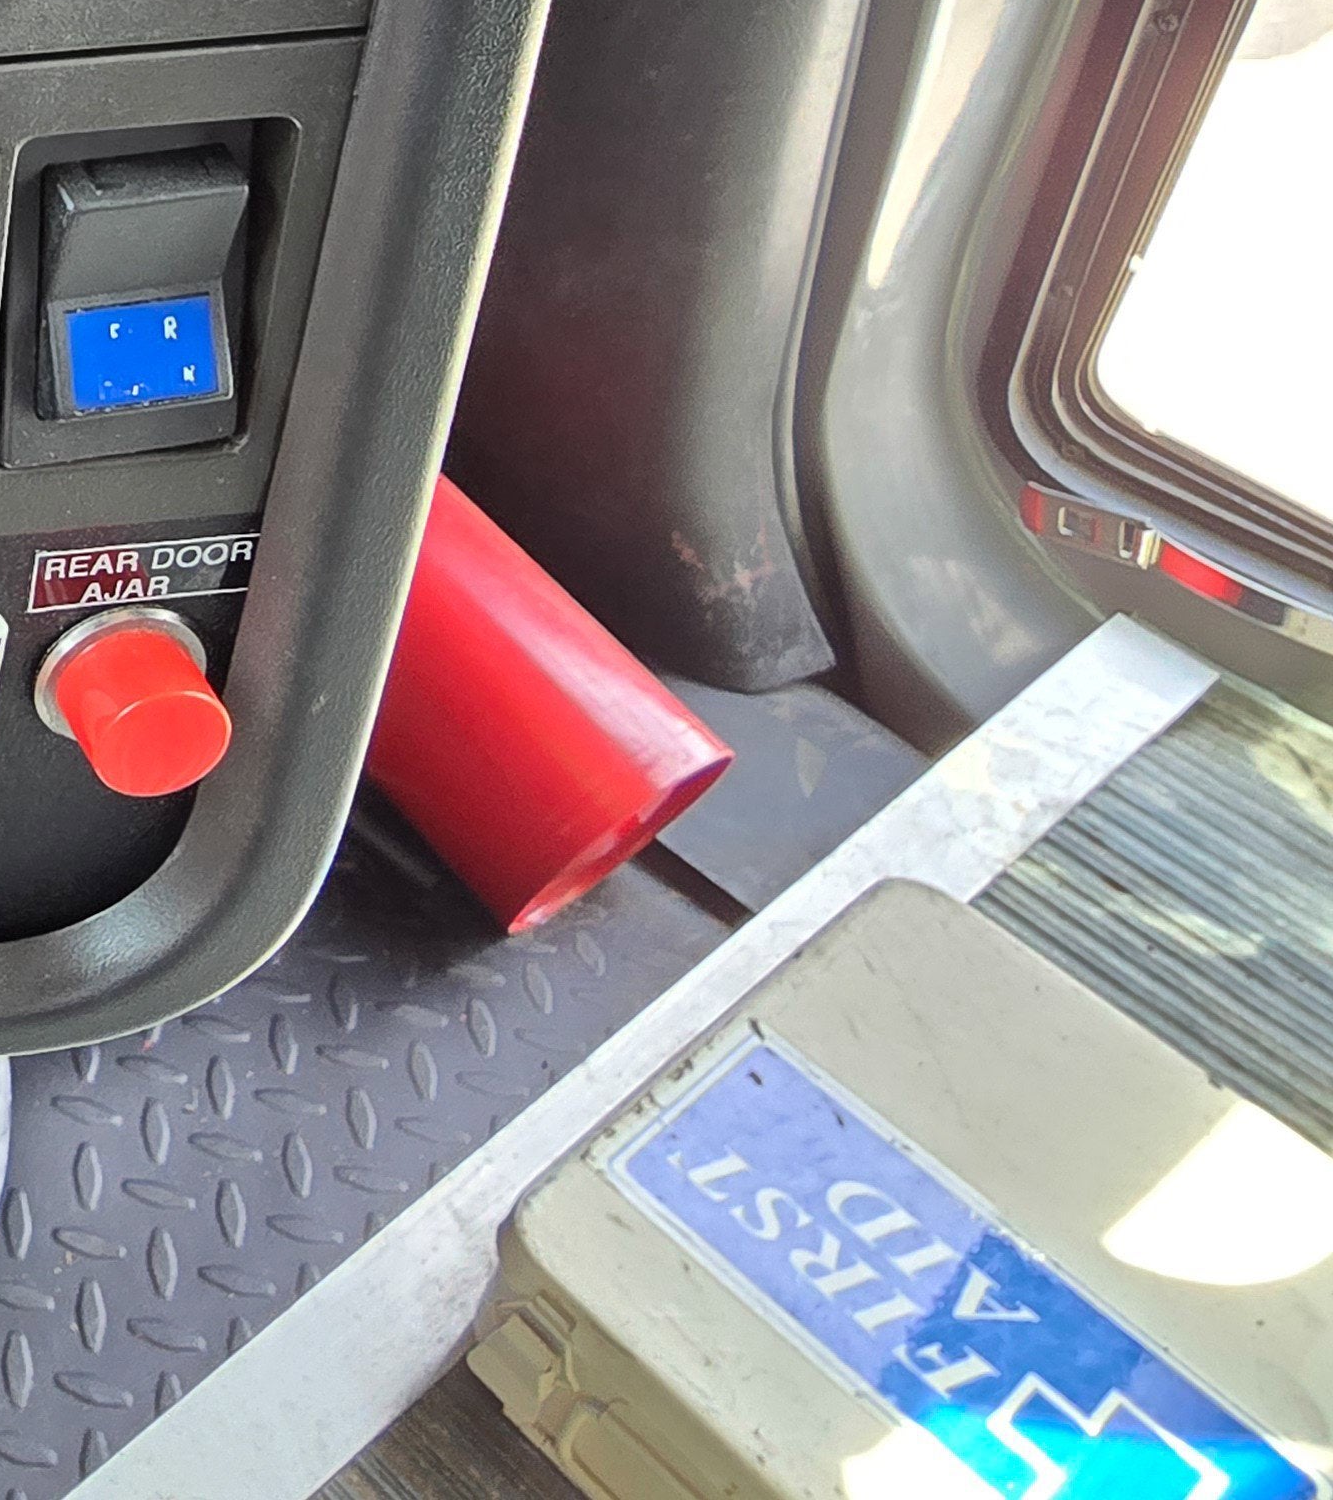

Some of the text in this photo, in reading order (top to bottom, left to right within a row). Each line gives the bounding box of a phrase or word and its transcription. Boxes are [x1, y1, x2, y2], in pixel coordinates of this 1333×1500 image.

[43, 540, 255, 582] REAR DOOR
[79, 575, 171, 604] AJAR
[667, 1145, 1002, 1399] FIRST
[825, 1180, 1042, 1324] AID
